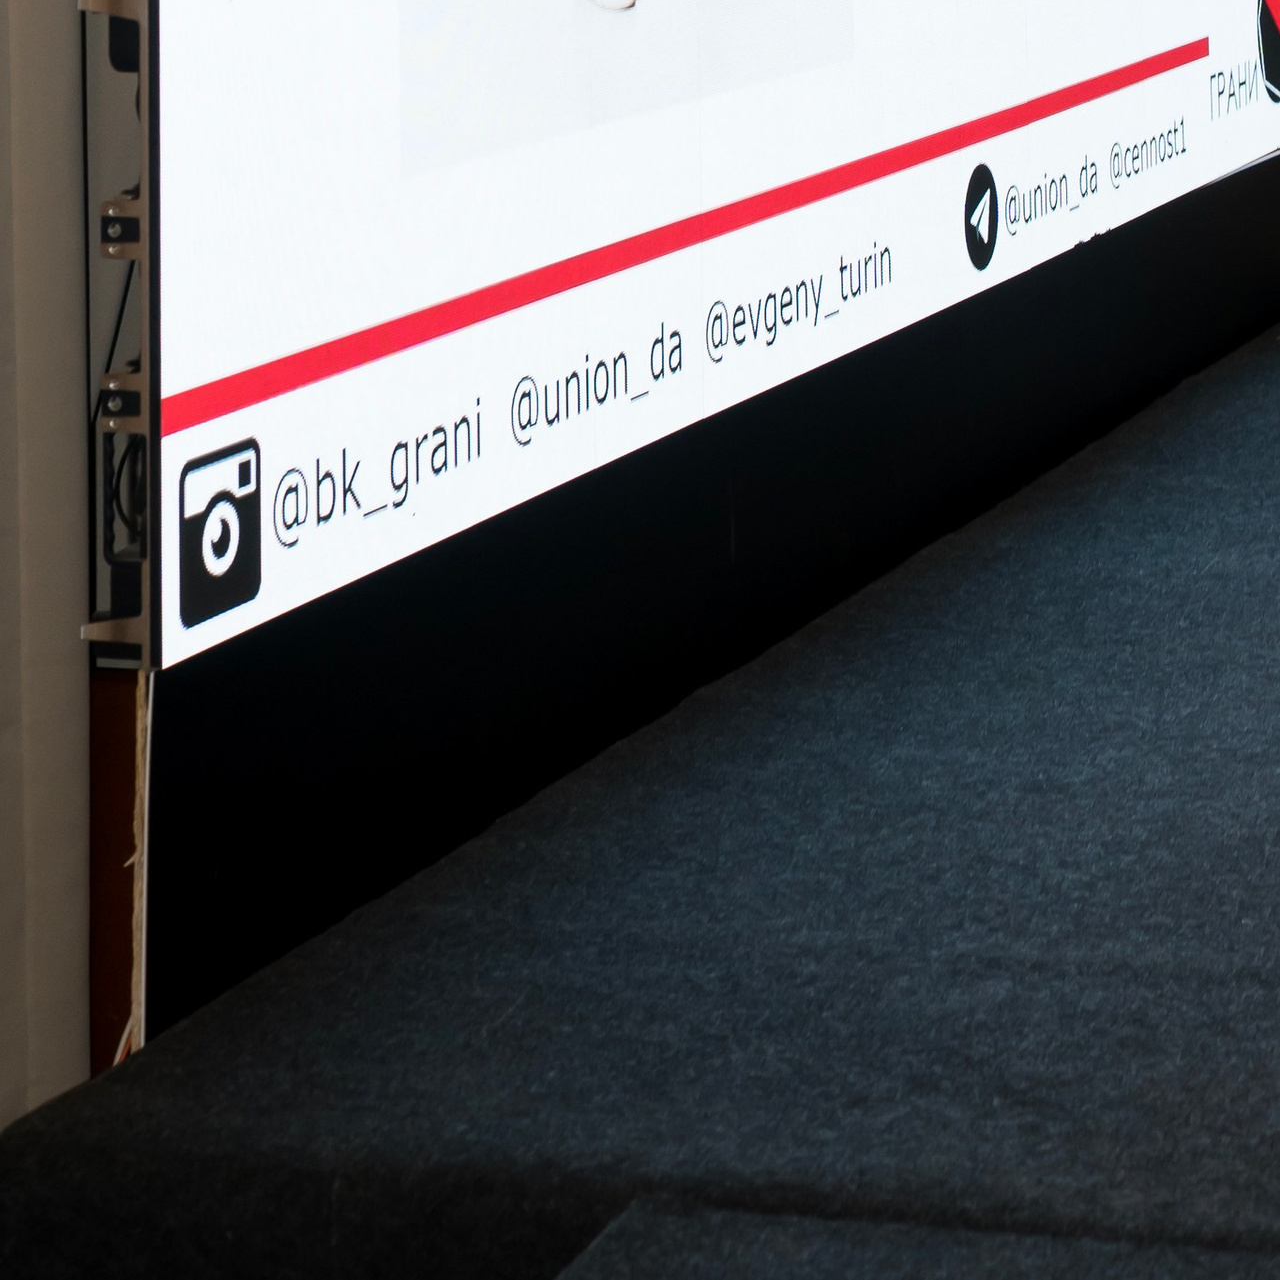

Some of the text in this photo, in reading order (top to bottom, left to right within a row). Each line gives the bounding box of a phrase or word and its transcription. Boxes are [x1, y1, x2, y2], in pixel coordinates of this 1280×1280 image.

[1209, 59, 1258, 121] ГРАНИ
[1005, 115, 1187, 236] @union_da @cennost1
[273, 241, 893, 548] @bk_grani @union_da @evgeny_turin
